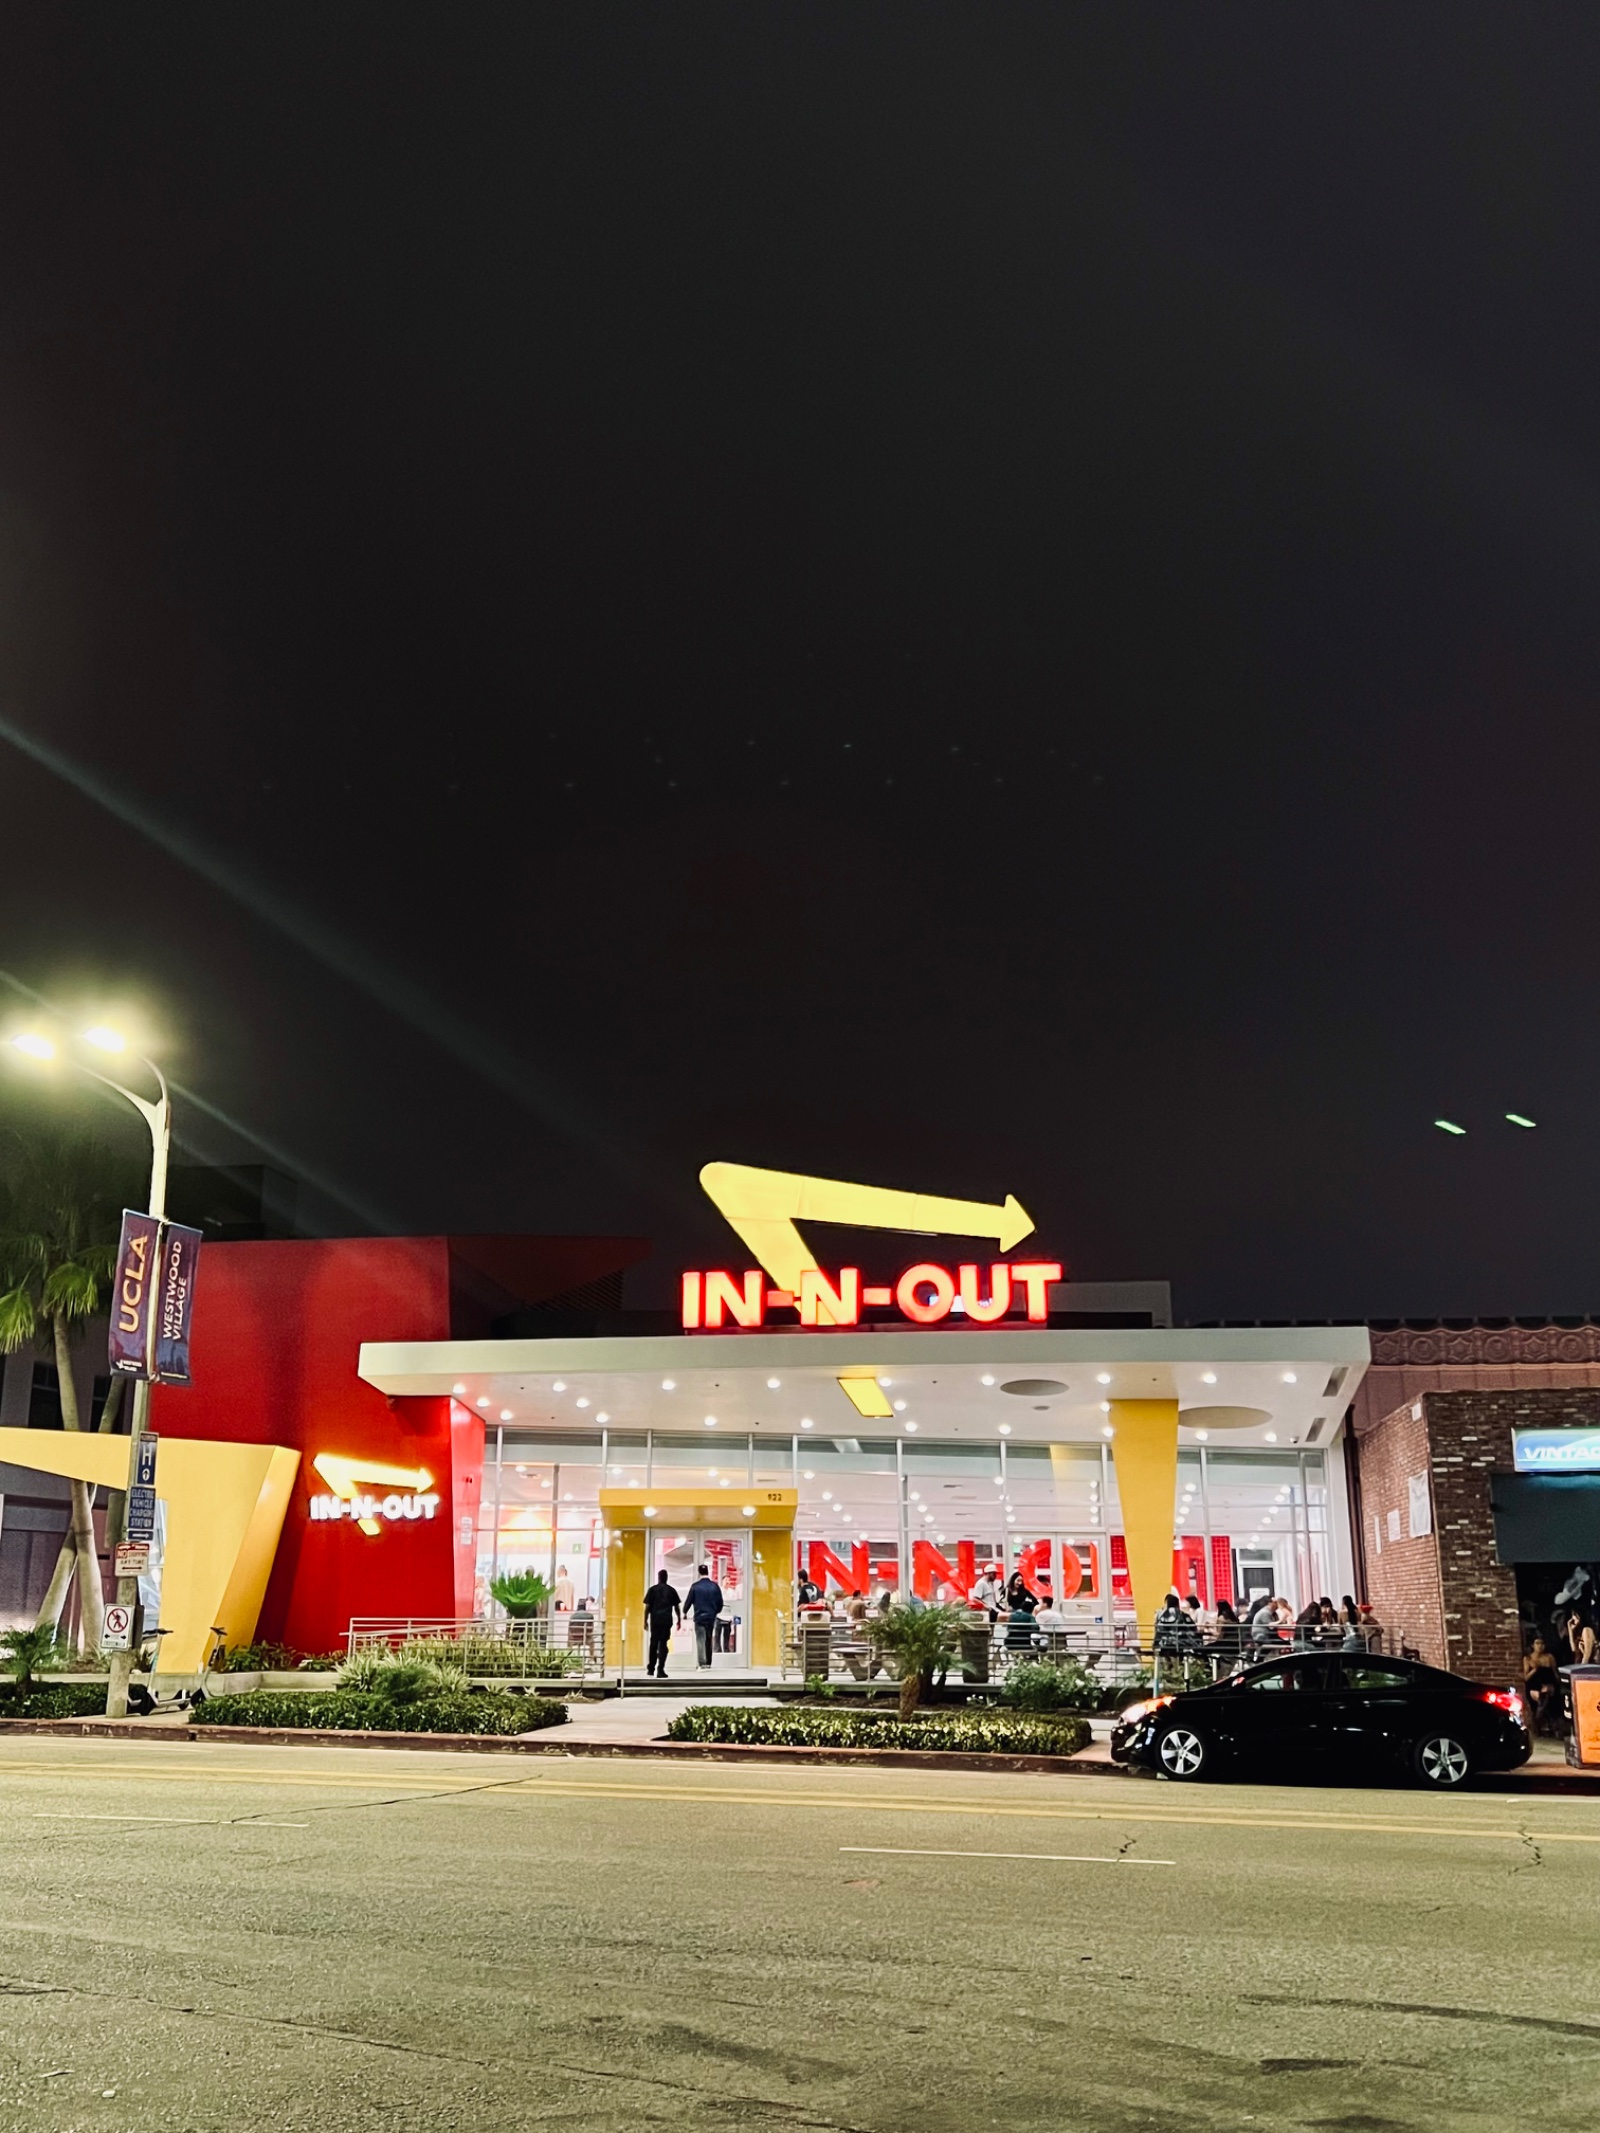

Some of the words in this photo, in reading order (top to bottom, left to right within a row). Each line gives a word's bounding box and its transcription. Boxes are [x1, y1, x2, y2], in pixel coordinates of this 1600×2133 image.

[119, 1235, 148, 1333] UCLA
[163, 1241, 182, 1339] WESTWOOD
[172, 1277, 187, 1341] VILLAGE
[681, 1263, 1062, 1329] IN-N-OUT
[142, 1444, 152, 1466] H
[310, 1494, 440, 1520] IN-N-OUT
